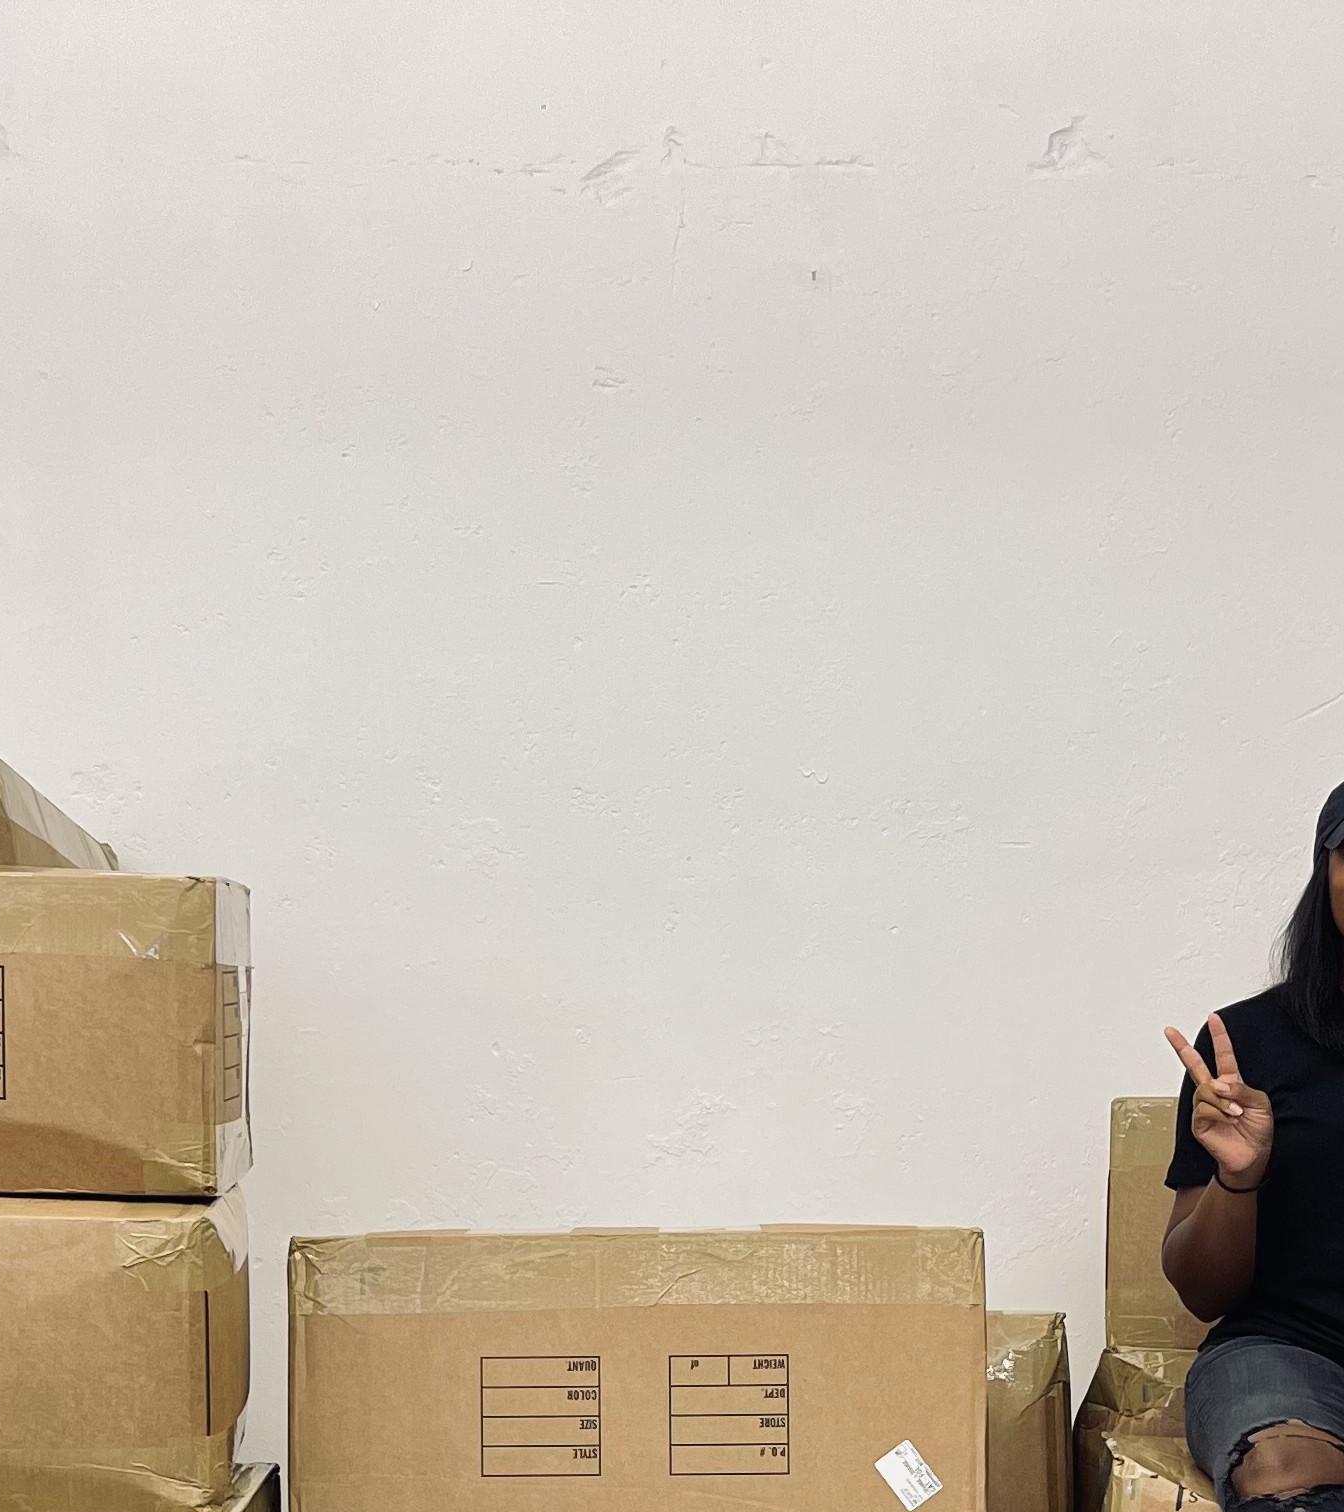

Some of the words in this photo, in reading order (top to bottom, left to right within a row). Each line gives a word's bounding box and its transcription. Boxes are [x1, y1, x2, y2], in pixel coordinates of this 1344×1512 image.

[752, 1359, 785, 1370] WEIGHT
[567, 1390, 597, 1401] COLOR
[579, 1419, 598, 1430] SIZE
[759, 1417, 786, 1428] STORE
[572, 1448, 598, 1459] STYLE
